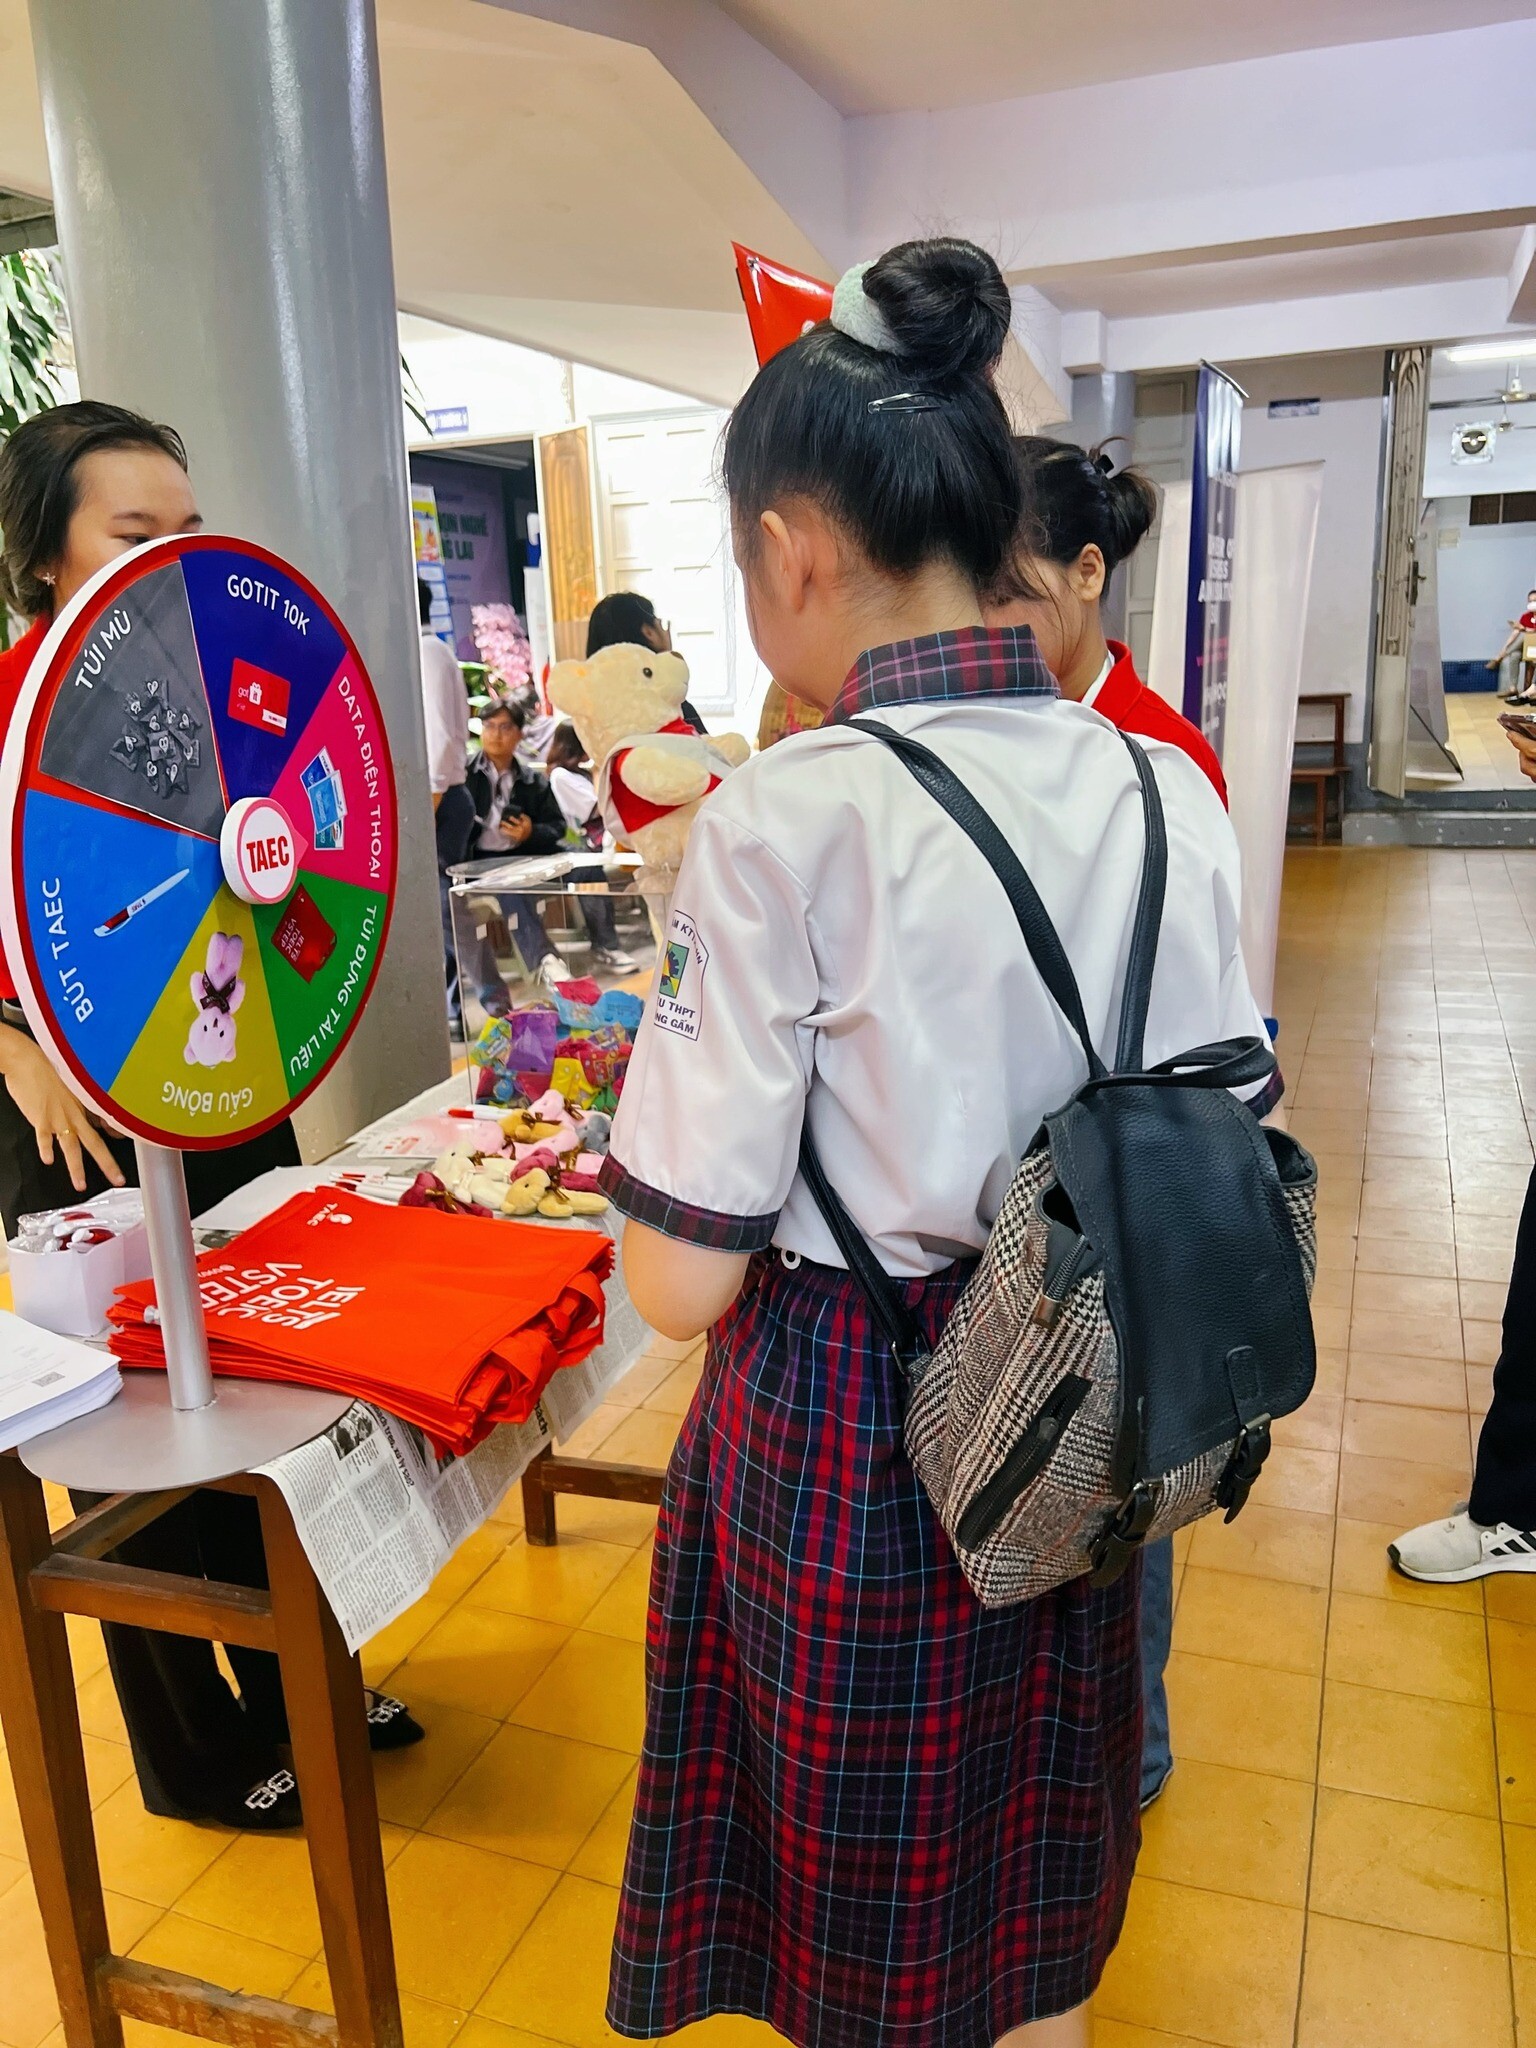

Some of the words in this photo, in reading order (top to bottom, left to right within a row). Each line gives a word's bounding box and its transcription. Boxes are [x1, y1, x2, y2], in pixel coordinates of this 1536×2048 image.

[227, 574, 280, 610] GOTIT
[284, 600, 310, 635] 10K
[75, 643, 106, 689] TÚI
[100, 609, 131, 650] MÙ
[338, 676, 366, 740] DATA
[361, 742, 379, 798] ĐIỆN
[246, 835, 290, 873] TAEC
[368, 805, 382, 878] THOẠI
[42, 877, 69, 960] TAEC
[281, 918, 297, 948] VSTEP
[361, 905, 377, 941] TÚI
[285, 928, 300, 954] TOEIC
[59, 967, 94, 1023] BÚT
[337, 944, 367, 1006] ĐỰNG
[318, 1008, 341, 1040] TÀI
[669, 1001, 696, 1019] THPT
[290, 1034, 320, 1076] LIỆU
[162, 1081, 214, 1116] BÔNG
[218, 1087, 253, 1119] GẤU
[217, 1277, 335, 1319] TOEIC
[261, 1286, 367, 1329] IELTS
